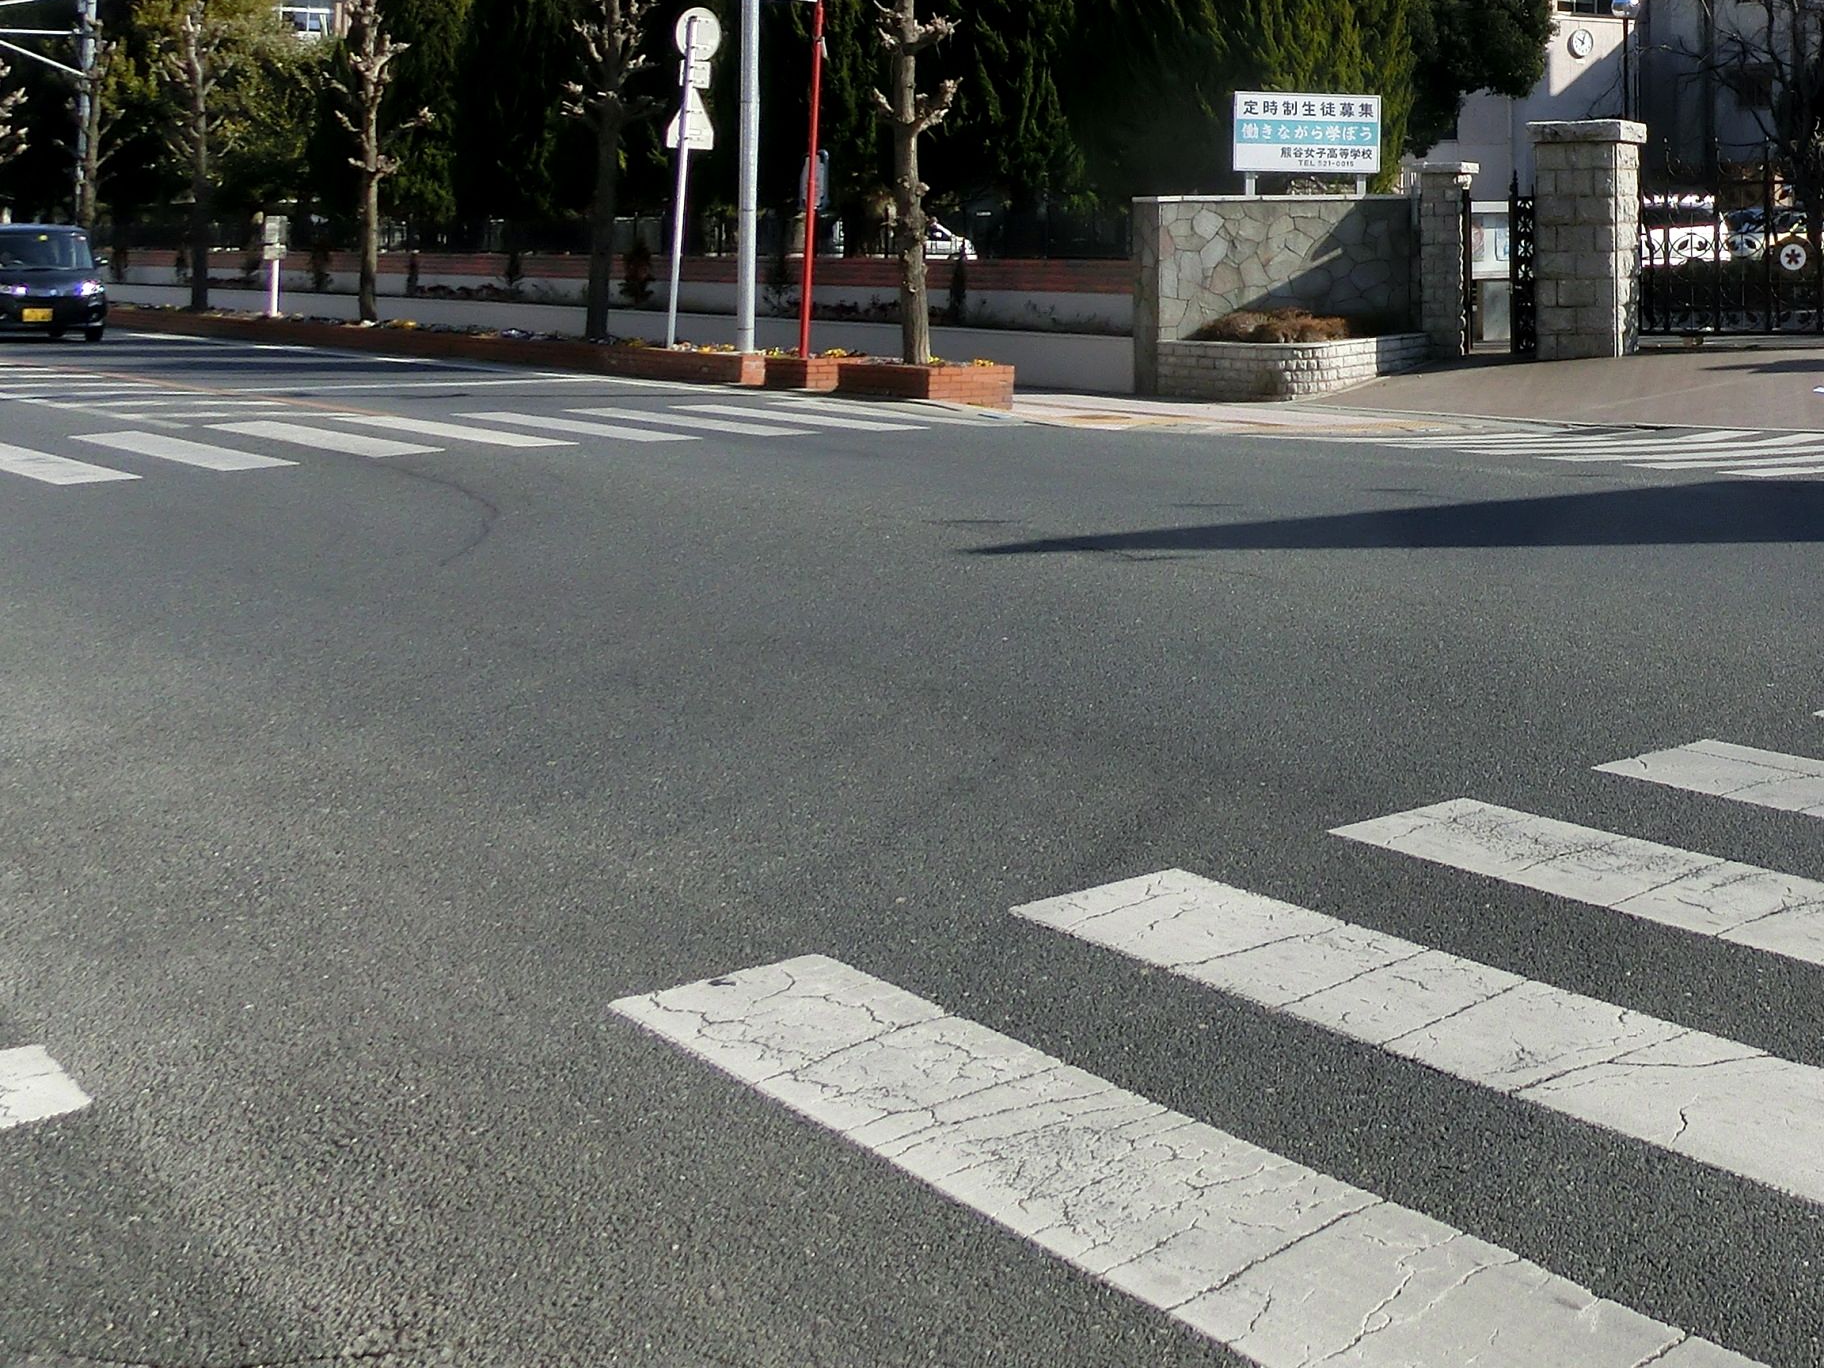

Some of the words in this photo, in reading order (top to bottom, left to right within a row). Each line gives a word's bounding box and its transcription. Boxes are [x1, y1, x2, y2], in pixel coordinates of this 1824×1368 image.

[1243, 100, 1374, 118] 定時制生徒募集
[1242, 122, 1373, 141] 働きながら学ぼう
[1280, 147, 1373, 160] 熊谷女子高等学校
